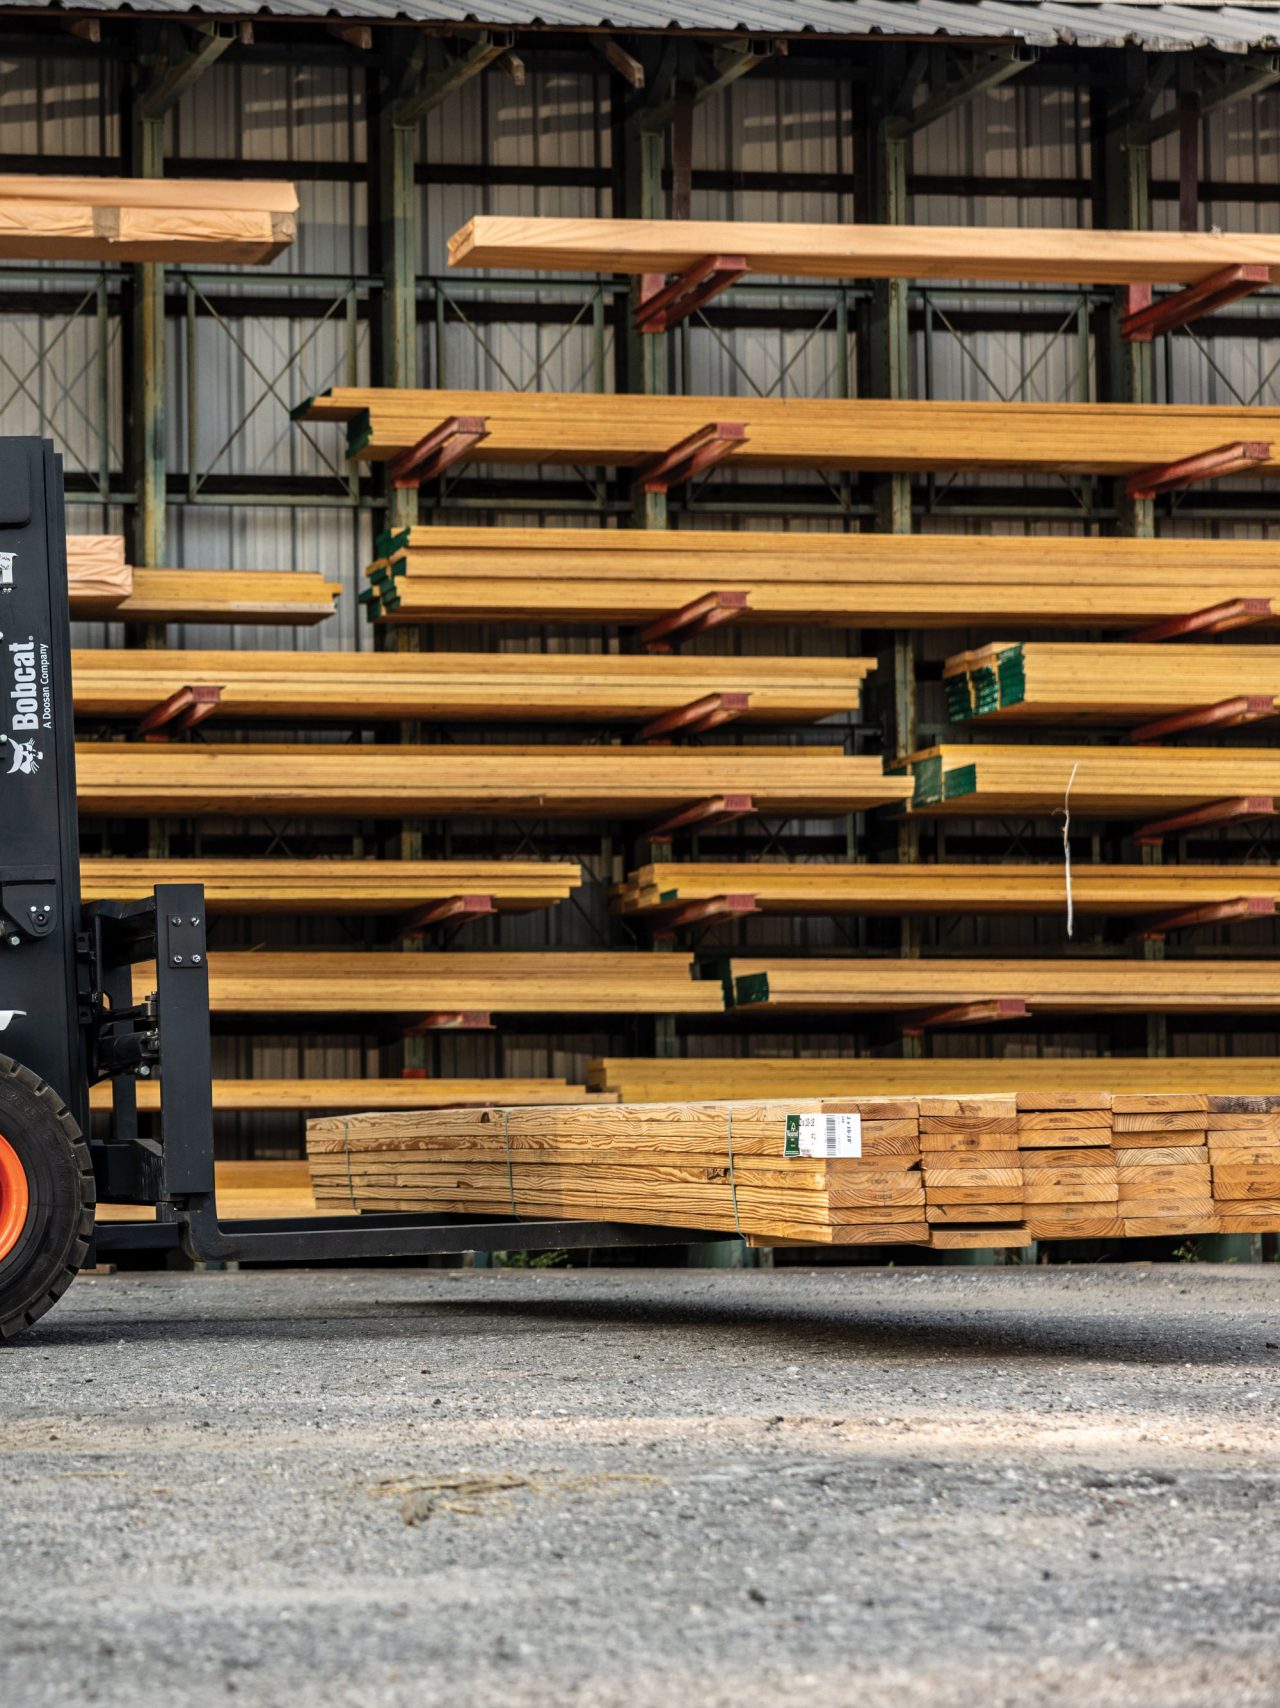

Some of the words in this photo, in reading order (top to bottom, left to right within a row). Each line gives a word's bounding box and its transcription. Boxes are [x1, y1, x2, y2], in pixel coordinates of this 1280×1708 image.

[40, 643, 50, 685] Company
[9, 642, 39, 730] Bobcat
[43, 686, 51, 720] Doosan
